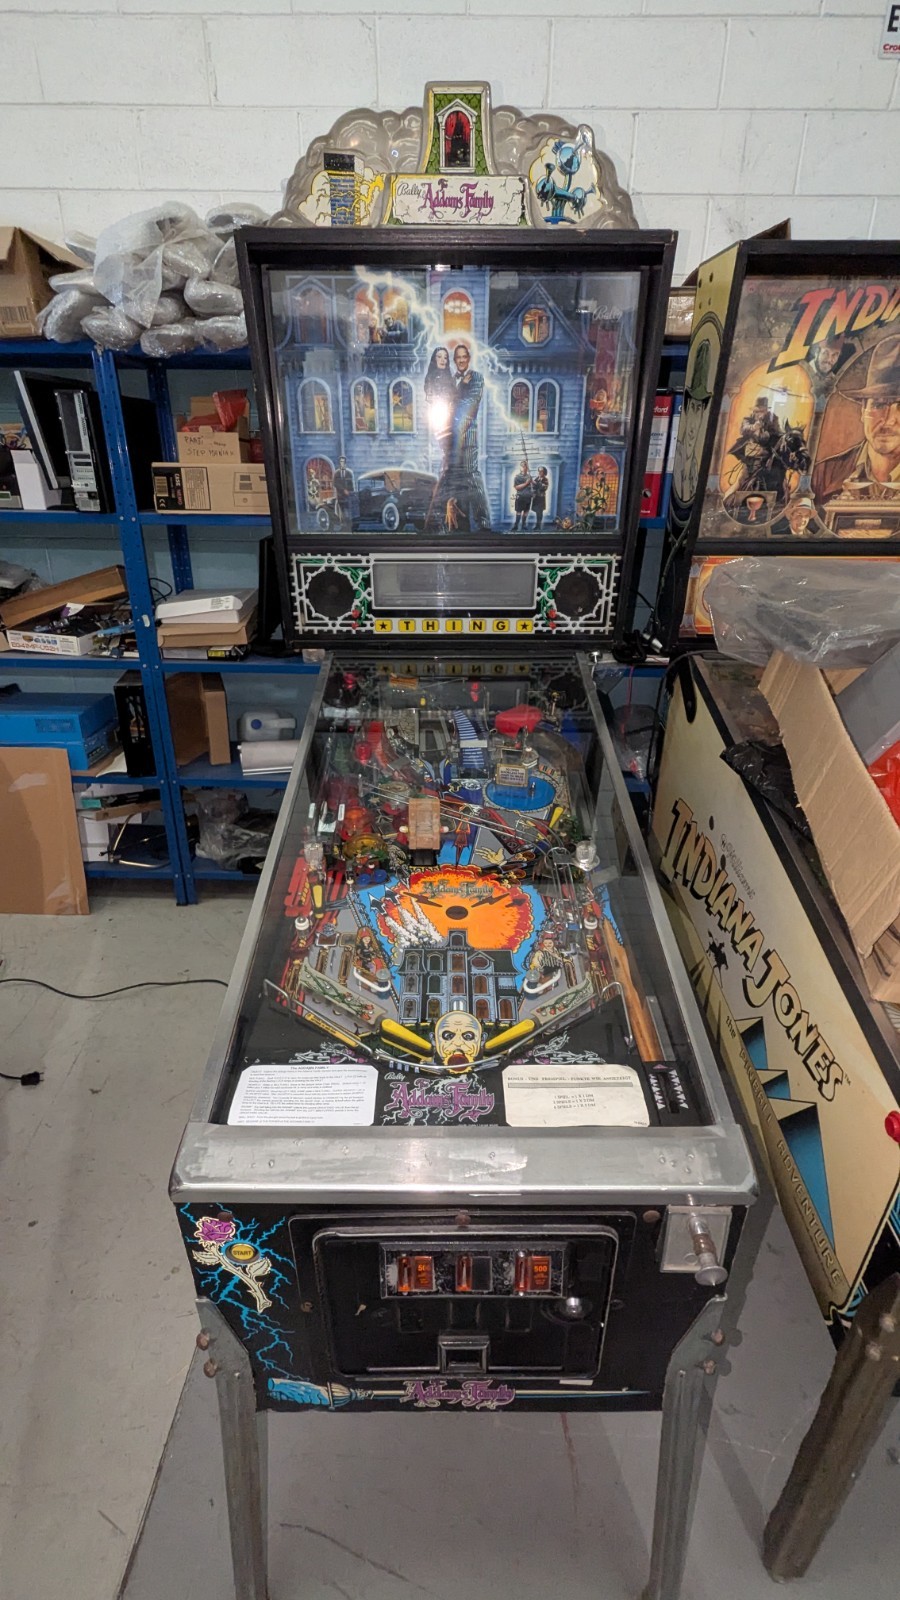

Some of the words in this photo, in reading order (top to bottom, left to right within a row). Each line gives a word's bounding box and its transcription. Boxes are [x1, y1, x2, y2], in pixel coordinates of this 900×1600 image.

[396, 183, 420, 198] Bally
[418, 182, 464, 219] Addams
[460, 181, 495, 220] Family
[660, 798, 765, 974] INDIANA
[742, 948, 844, 1102] JONES
[725, 1014, 736, 1039] the
[384, 1072, 406, 1081] Bally
[384, 1081, 453, 1118] Addams
[444, 1078, 495, 1122] Family
[776, 1137, 842, 1286] ADVENTURE
[399, 1380, 463, 1407] Addams
[461, 1379, 516, 1410] Family
